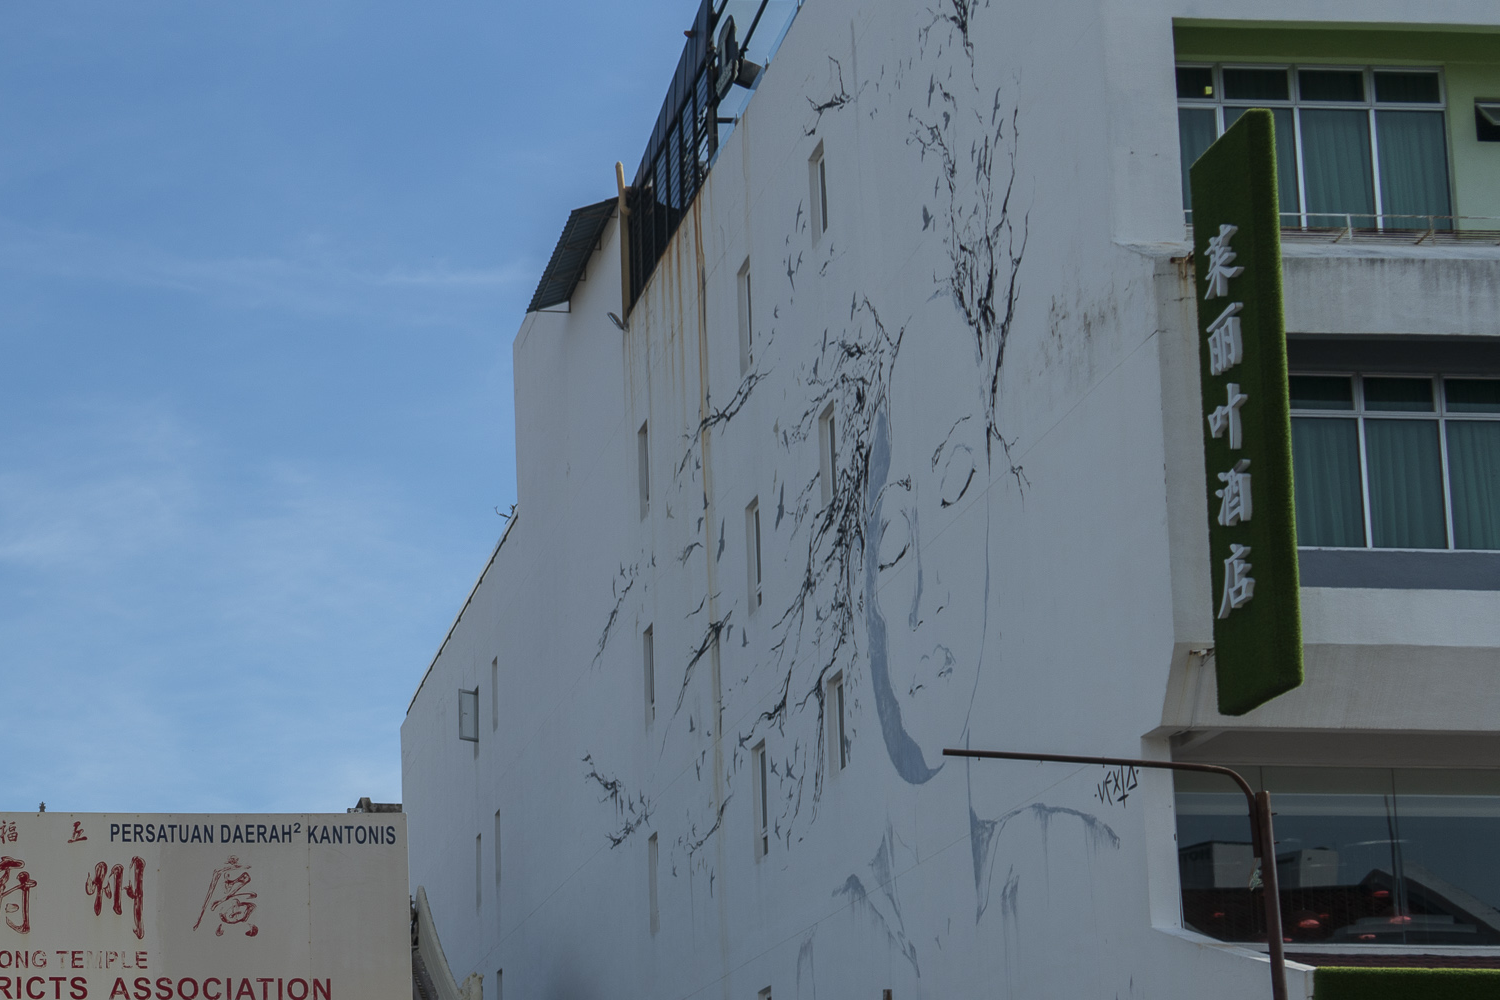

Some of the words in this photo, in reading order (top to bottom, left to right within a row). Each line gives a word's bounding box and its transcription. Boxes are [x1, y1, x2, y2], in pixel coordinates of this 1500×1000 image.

[1204, 224, 1256, 620] 莱丽叶酒店
[110, 823, 214, 844] PERSATUAN
[307, 825, 396, 845] KANTONIS
[56, 950, 148, 969] TEMPLE
